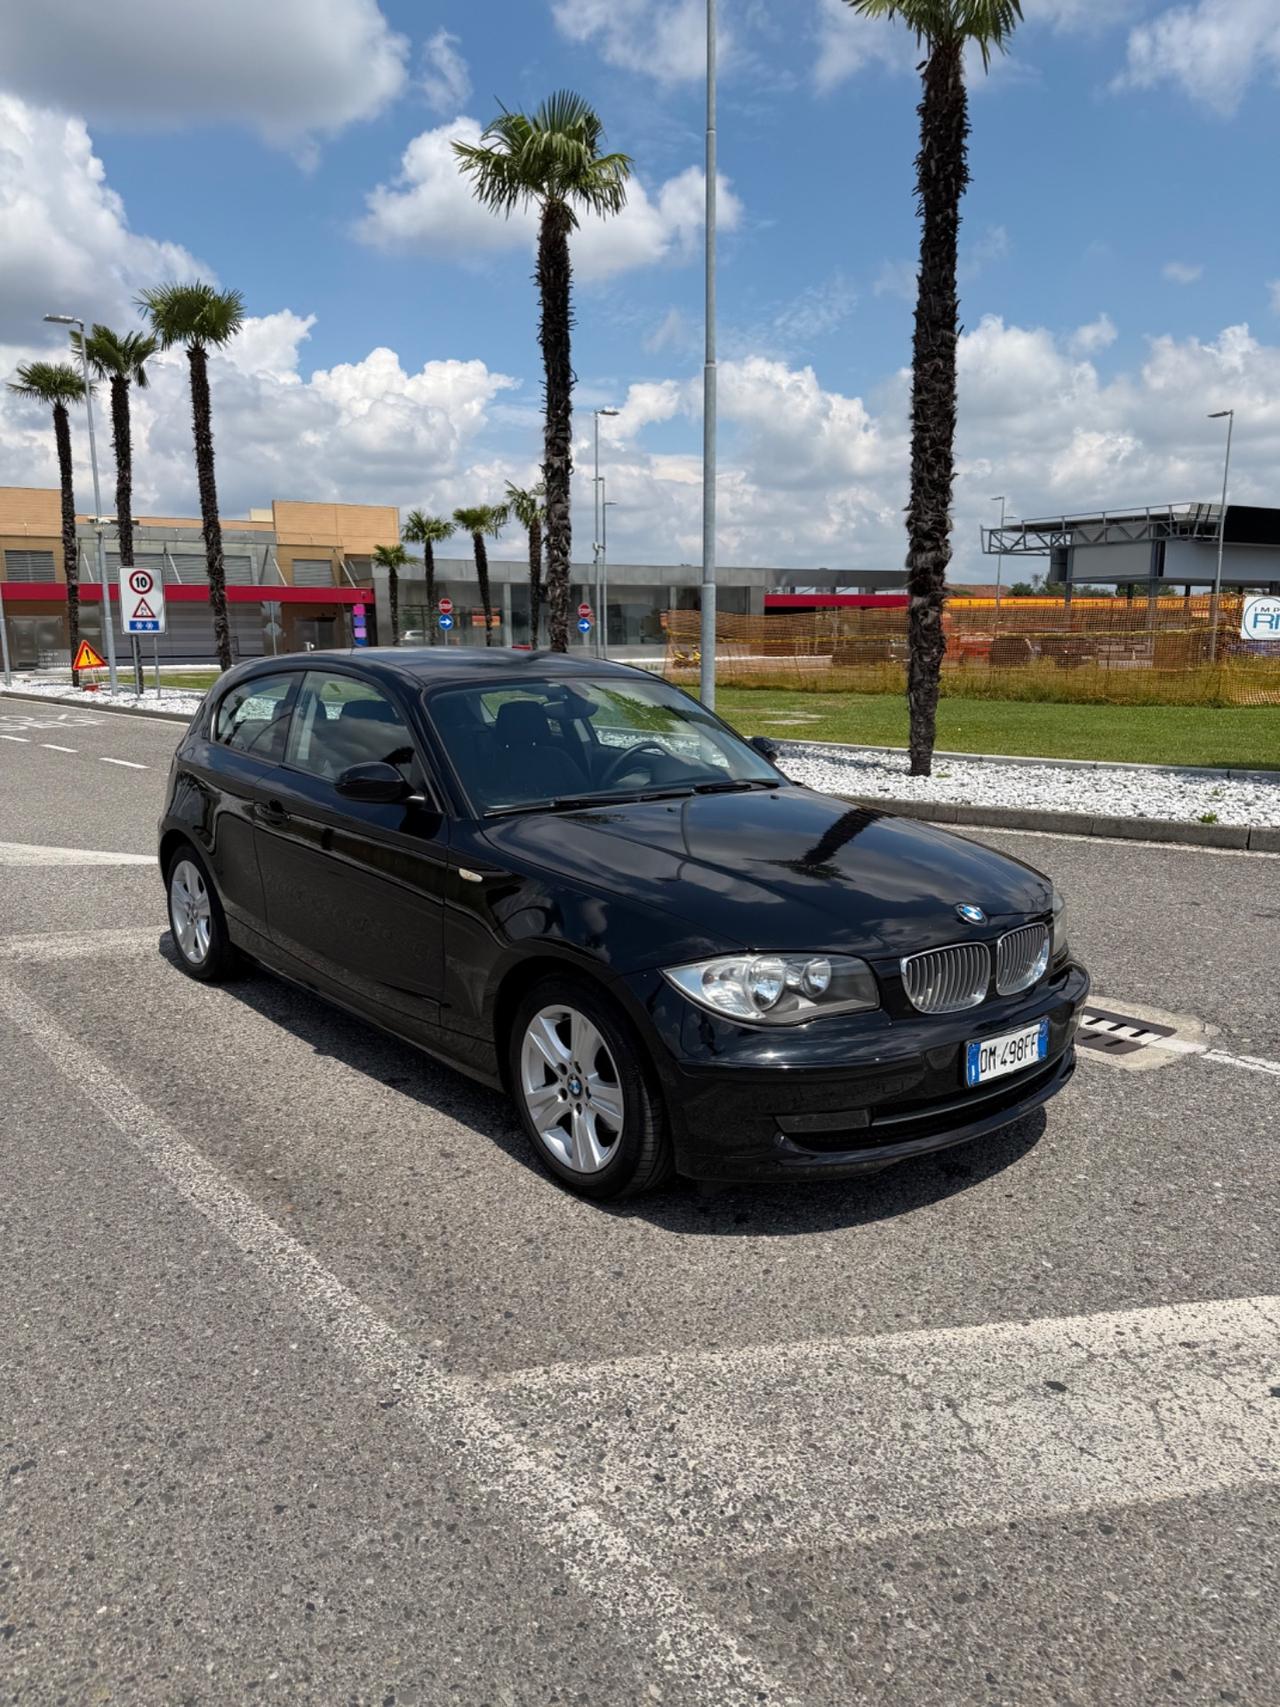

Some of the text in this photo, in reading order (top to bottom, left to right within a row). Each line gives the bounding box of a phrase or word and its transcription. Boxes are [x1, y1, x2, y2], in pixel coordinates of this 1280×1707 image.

[135, 576, 147, 588] 10
[980, 1031, 1038, 1074] DM 498FF
